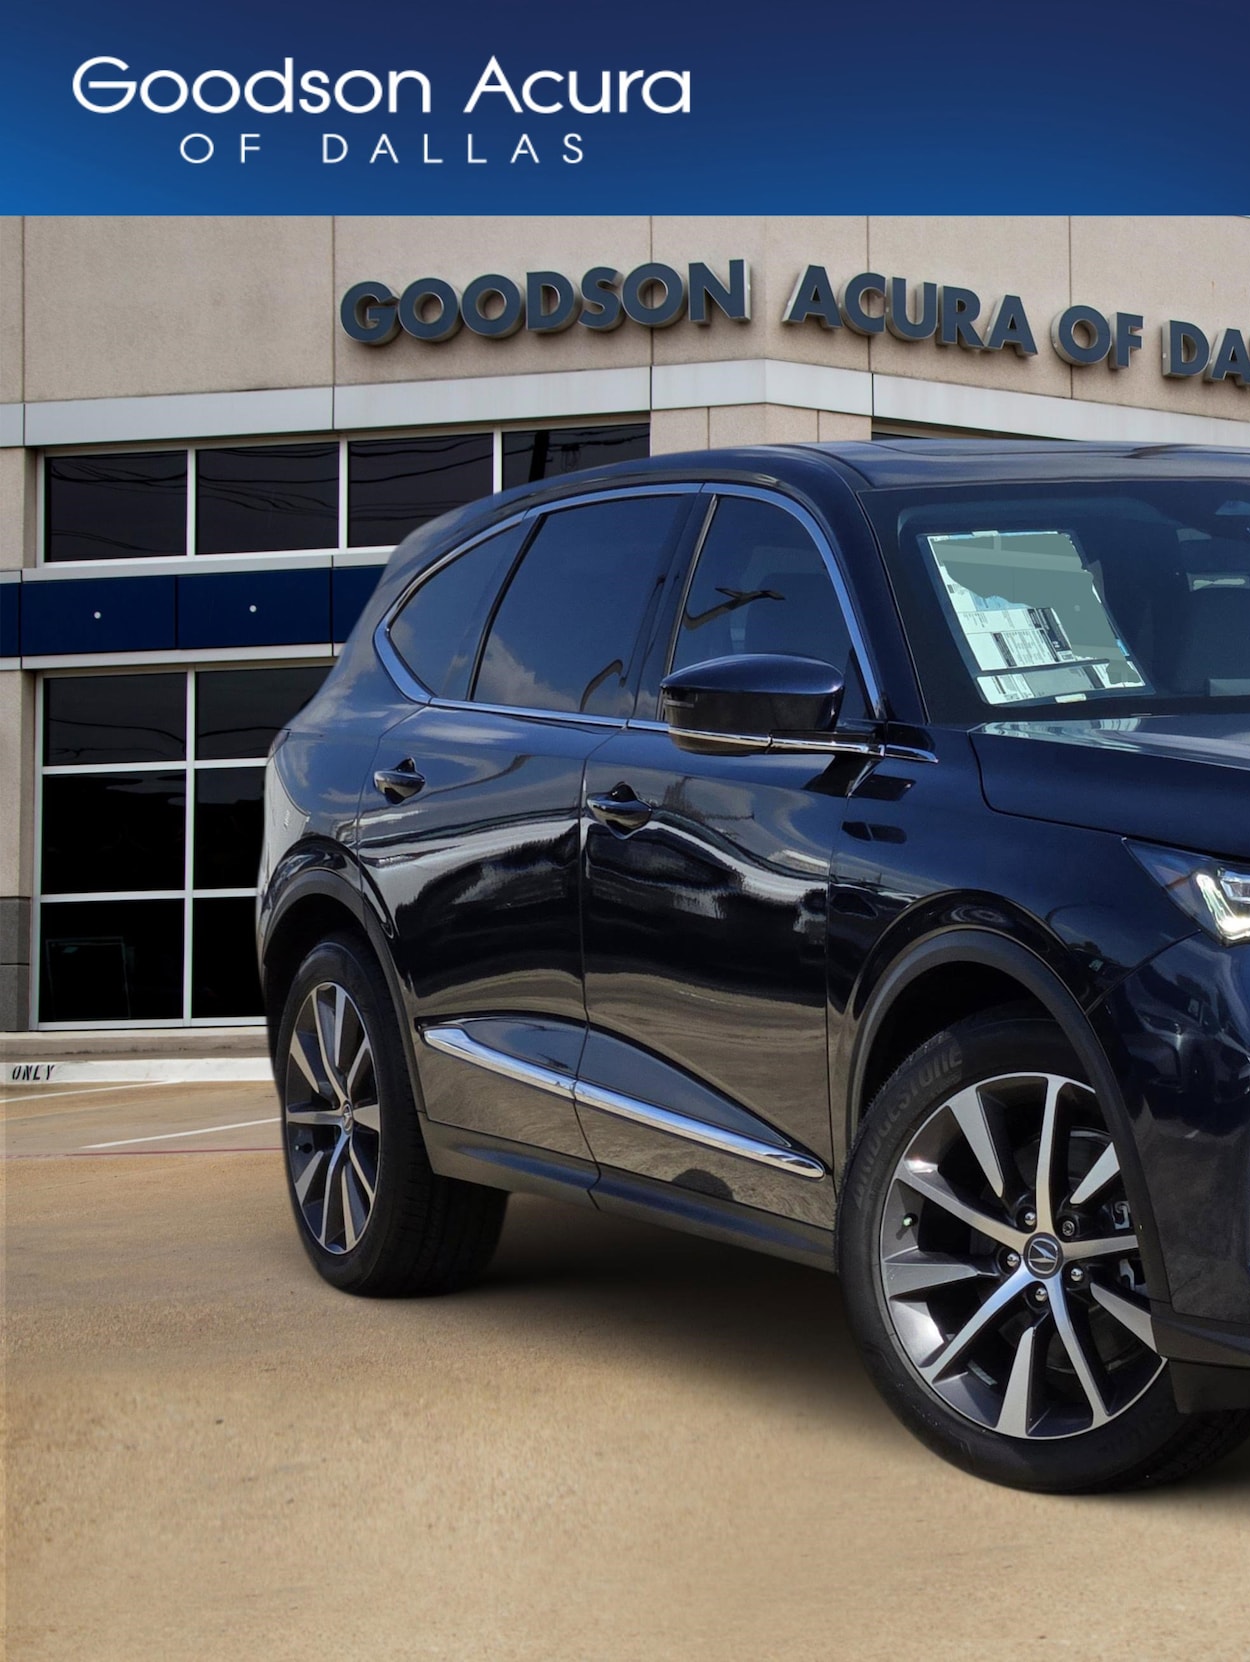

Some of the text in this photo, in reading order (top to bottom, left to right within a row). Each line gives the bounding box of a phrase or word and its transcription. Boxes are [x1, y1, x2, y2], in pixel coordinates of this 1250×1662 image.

[340, 259, 751, 346] GOODSON
[782, 264, 1038, 357] ACURA
[1051, 305, 1143, 370] OF
[12, 1065, 55, 1080] ONLY
